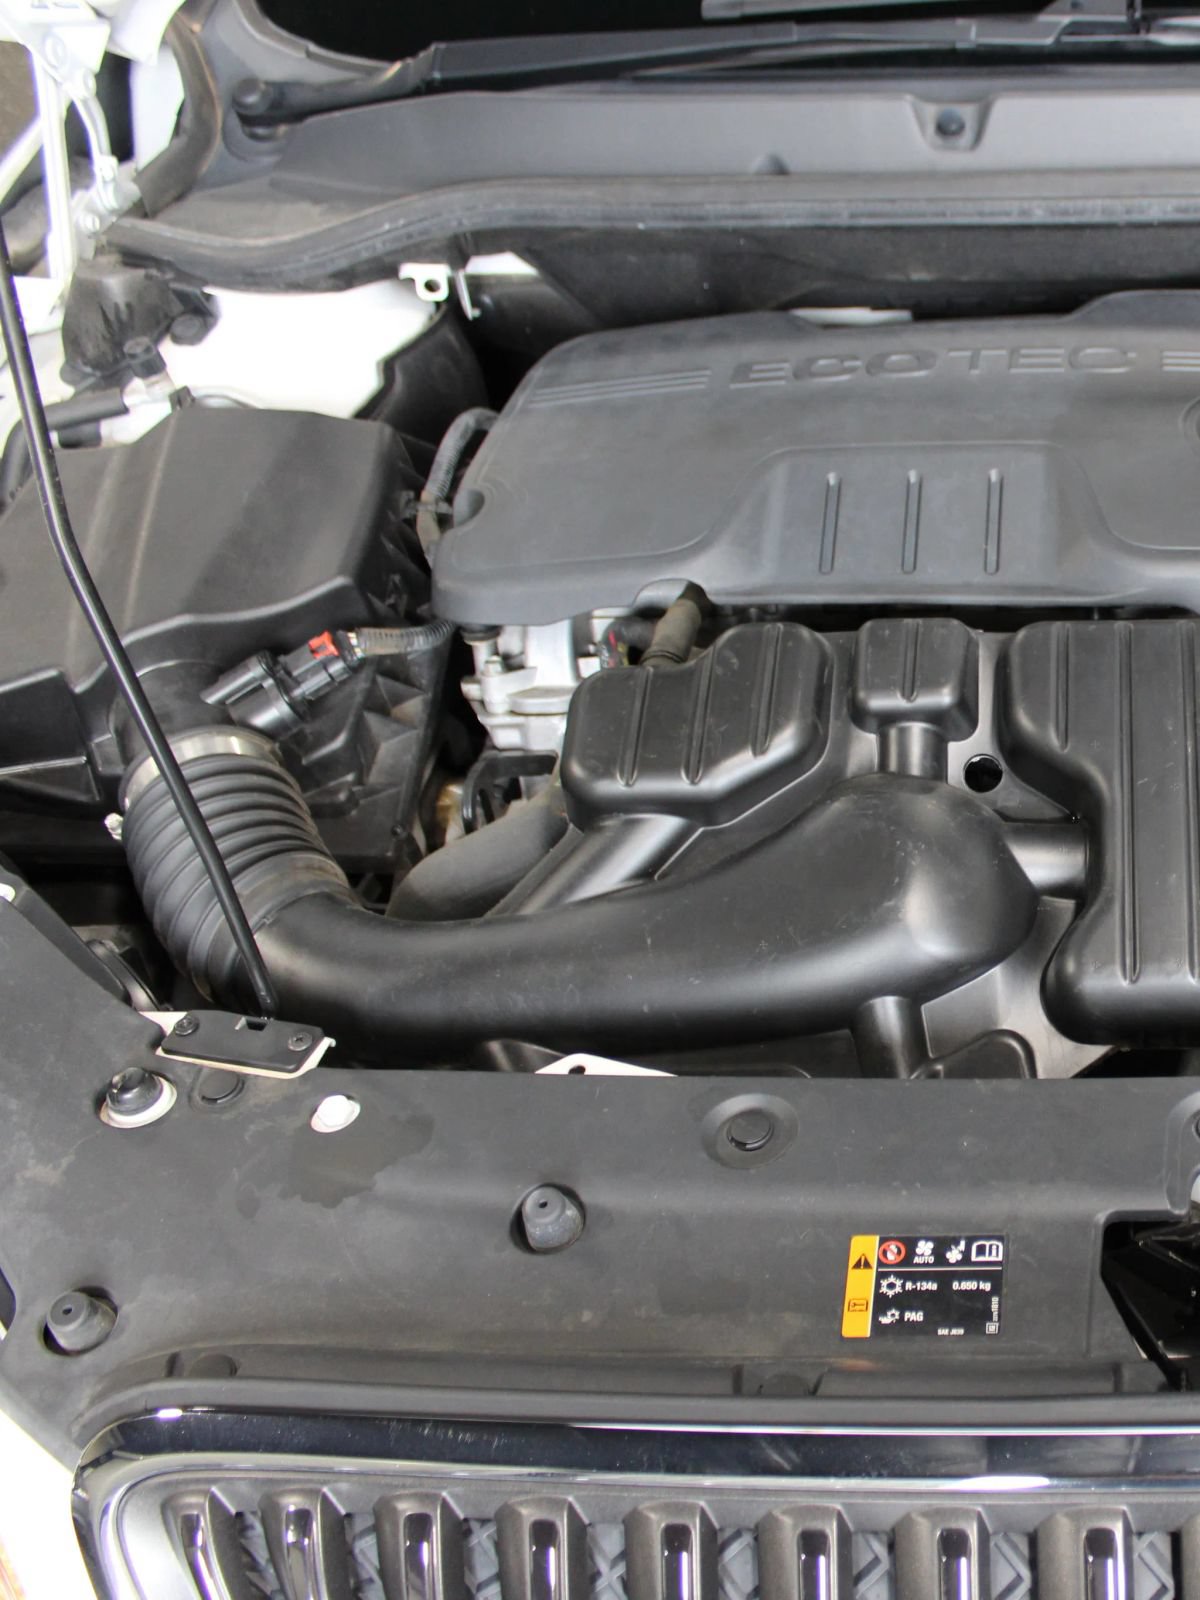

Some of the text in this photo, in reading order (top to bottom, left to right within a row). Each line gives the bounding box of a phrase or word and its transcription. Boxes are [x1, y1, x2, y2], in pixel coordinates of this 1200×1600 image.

[729, 347, 1137, 390] ECOTEC
[913, 1256, 934, 1264] AUTO
[905, 1281, 992, 1292] R-134a 0.650 kg
[904, 1311, 924, 1322] PAG
